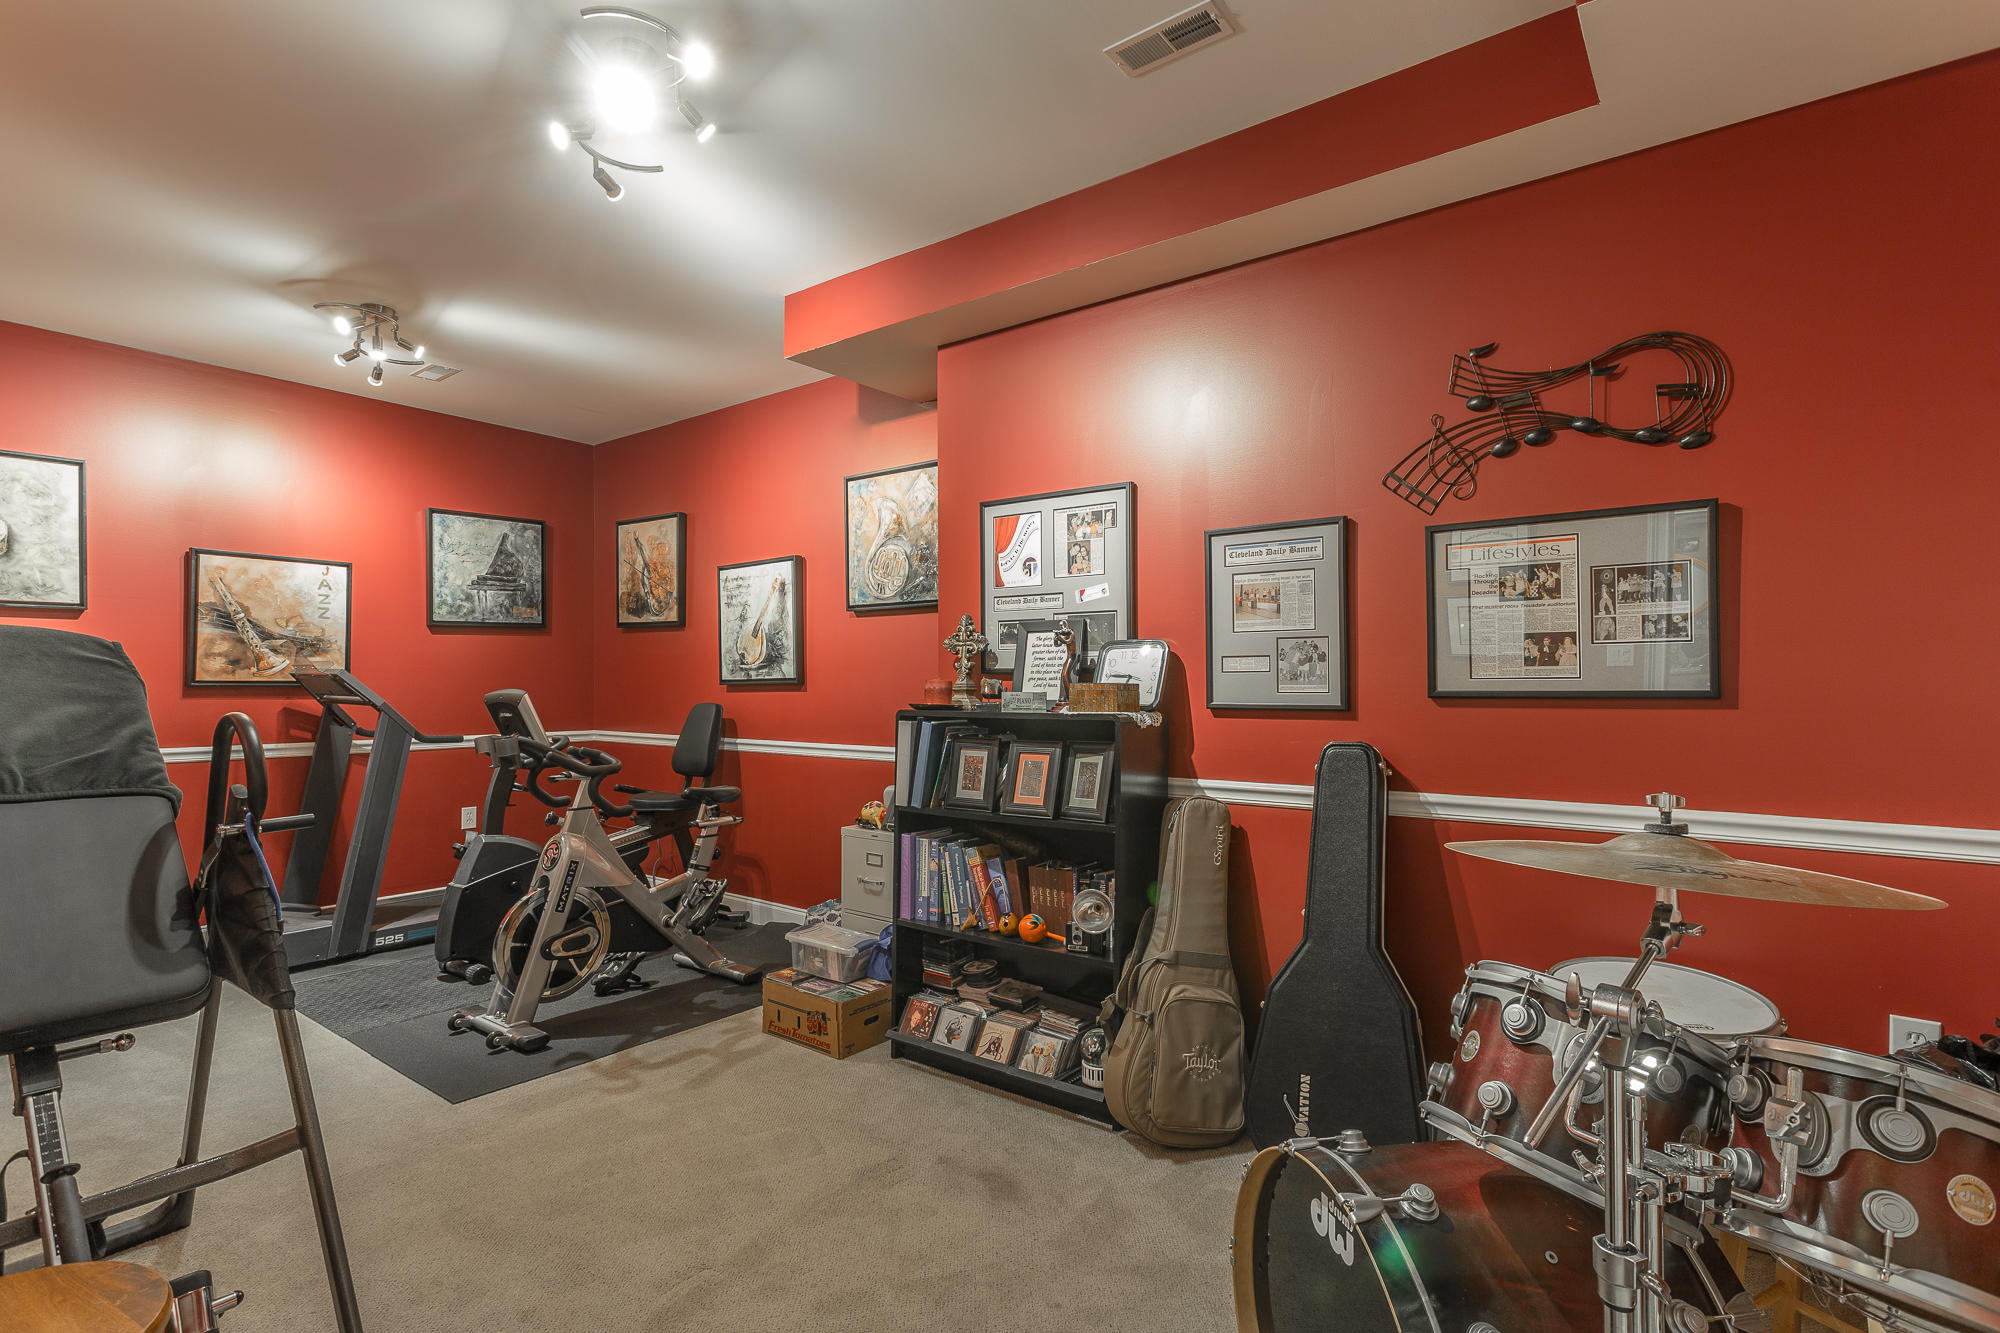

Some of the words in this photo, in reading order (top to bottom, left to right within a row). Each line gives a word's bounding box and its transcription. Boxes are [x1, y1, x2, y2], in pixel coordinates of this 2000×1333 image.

[1229, 549, 1263, 559] Cleveland
[1265, 547, 1287, 556] Daily
[1289, 545, 1318, 554] Banner
[1470, 543, 1561, 561] Lifestyles
[1474, 578, 1498, 586] Through
[317, 566, 332, 620] JAZZ
[996, 598, 1021, 606] Cleveland
[1023, 597, 1039, 605] Daily
[1151, 657, 1159, 668] 2
[1150, 671, 1157, 682] 3
[1146, 685, 1153, 694] 4
[1016, 697, 1032, 705] PIANO
[557, 861, 578, 912] MATRIX
[375, 933, 405, 946] 525
[768, 1020, 792, 1037] Fresh
[792, 1027, 831, 1050] Tomatoes
[1182, 1052, 1219, 1072] Taylor
[1294, 1074, 1311, 1137] OVATION
[1328, 1199, 1354, 1233] drums
[1310, 1191, 1354, 1266] dw
